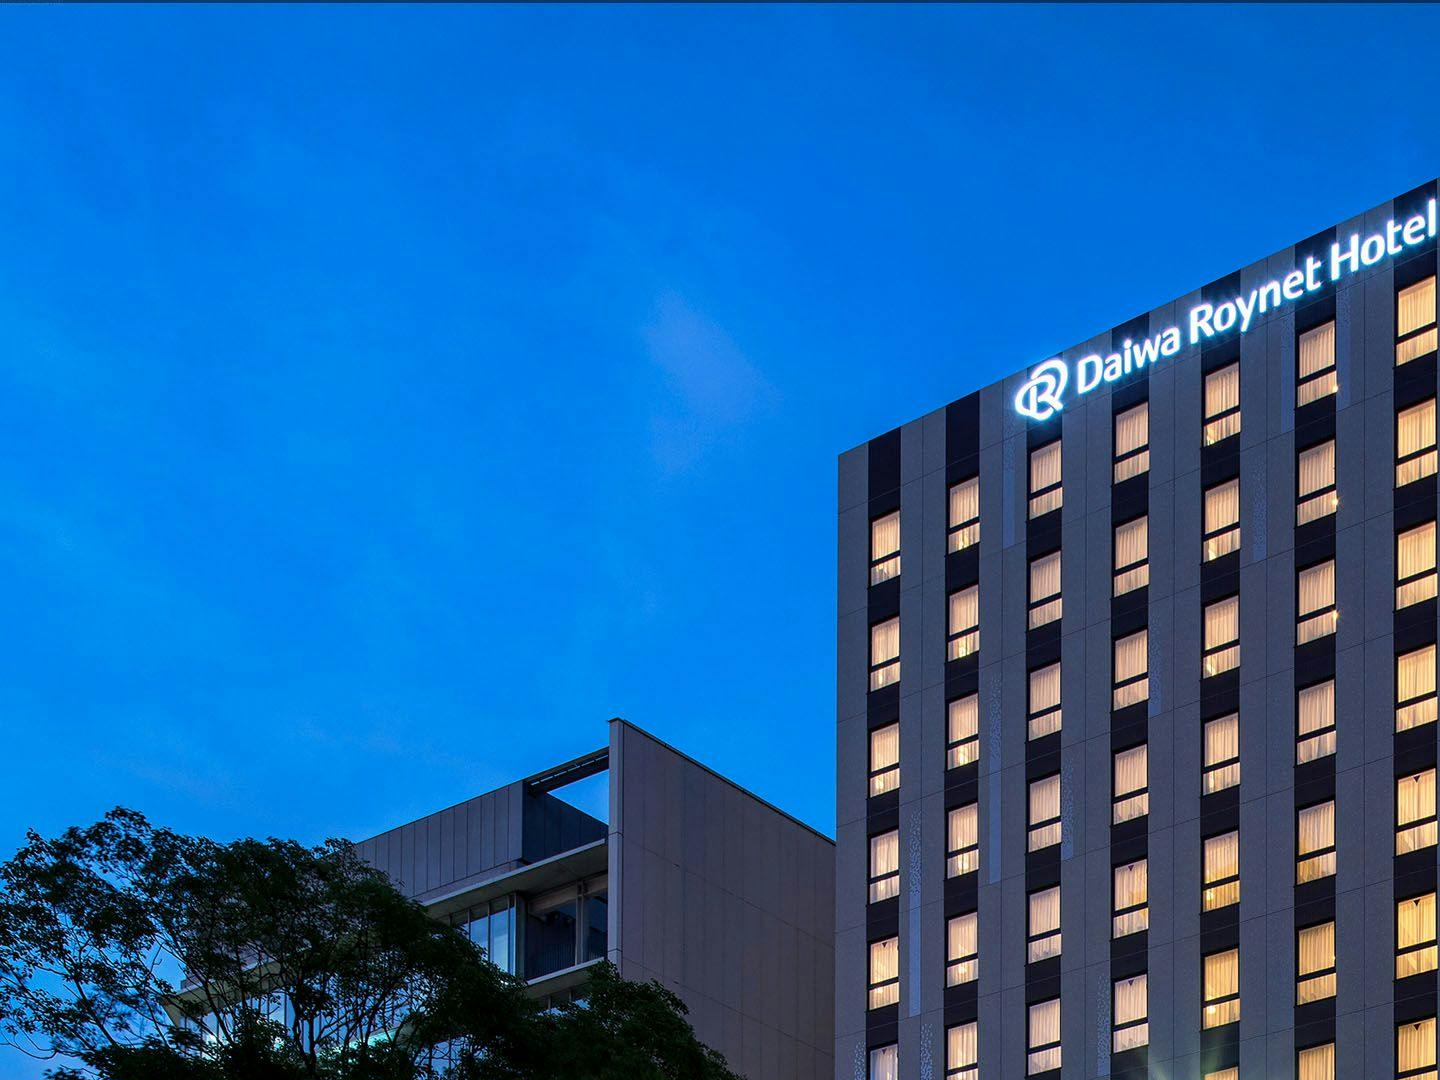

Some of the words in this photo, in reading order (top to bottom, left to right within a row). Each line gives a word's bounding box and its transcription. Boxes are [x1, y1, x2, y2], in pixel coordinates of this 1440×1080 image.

[1077, 326, 1180, 395] Daiwa
[1189, 256, 1322, 345] Roynet
[1331, 198, 1437, 280] Hotel
